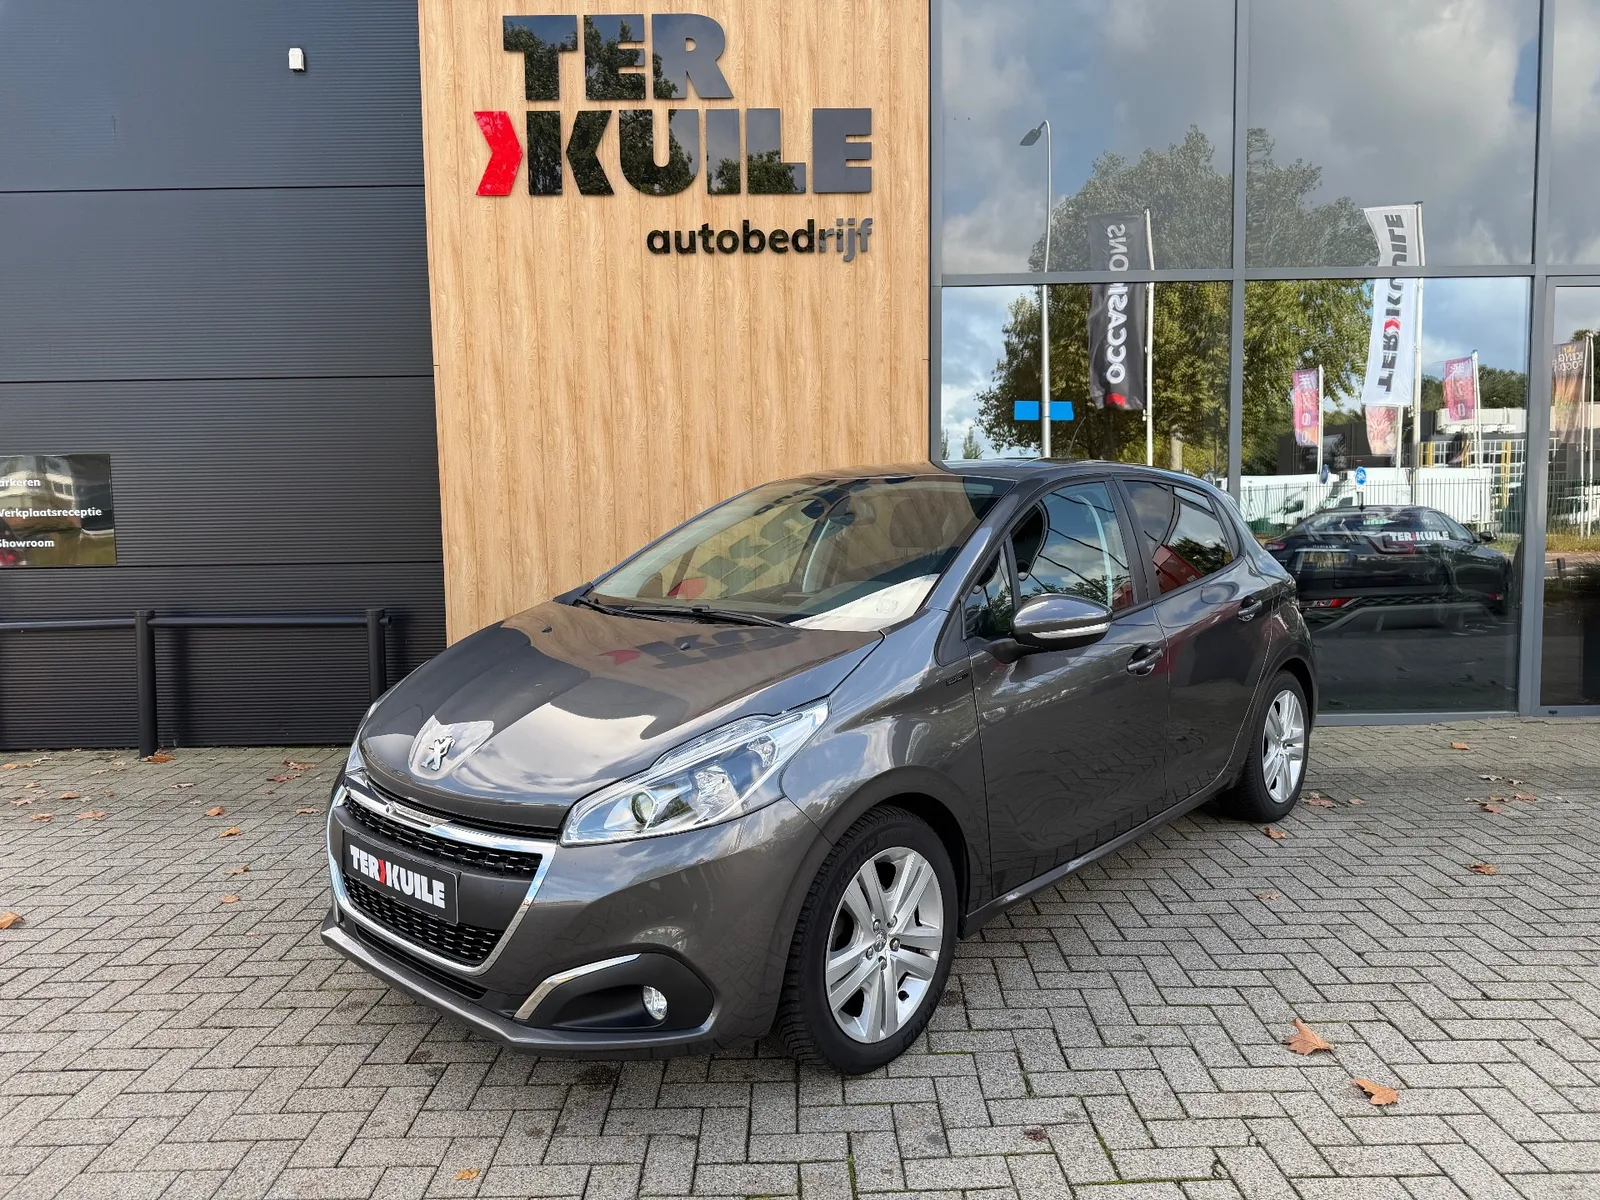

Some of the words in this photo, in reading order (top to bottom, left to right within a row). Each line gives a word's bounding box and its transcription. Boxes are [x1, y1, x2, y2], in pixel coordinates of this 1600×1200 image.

[502, 13, 734, 100] TER
[526, 108, 872, 196] KUILE
[647, 217, 873, 262] autobedrijf
[1389, 532, 1412, 541] TER
[1416, 531, 1450, 541] KUILE
[350, 845, 381, 884] TER
[385, 861, 445, 909] KUILE
